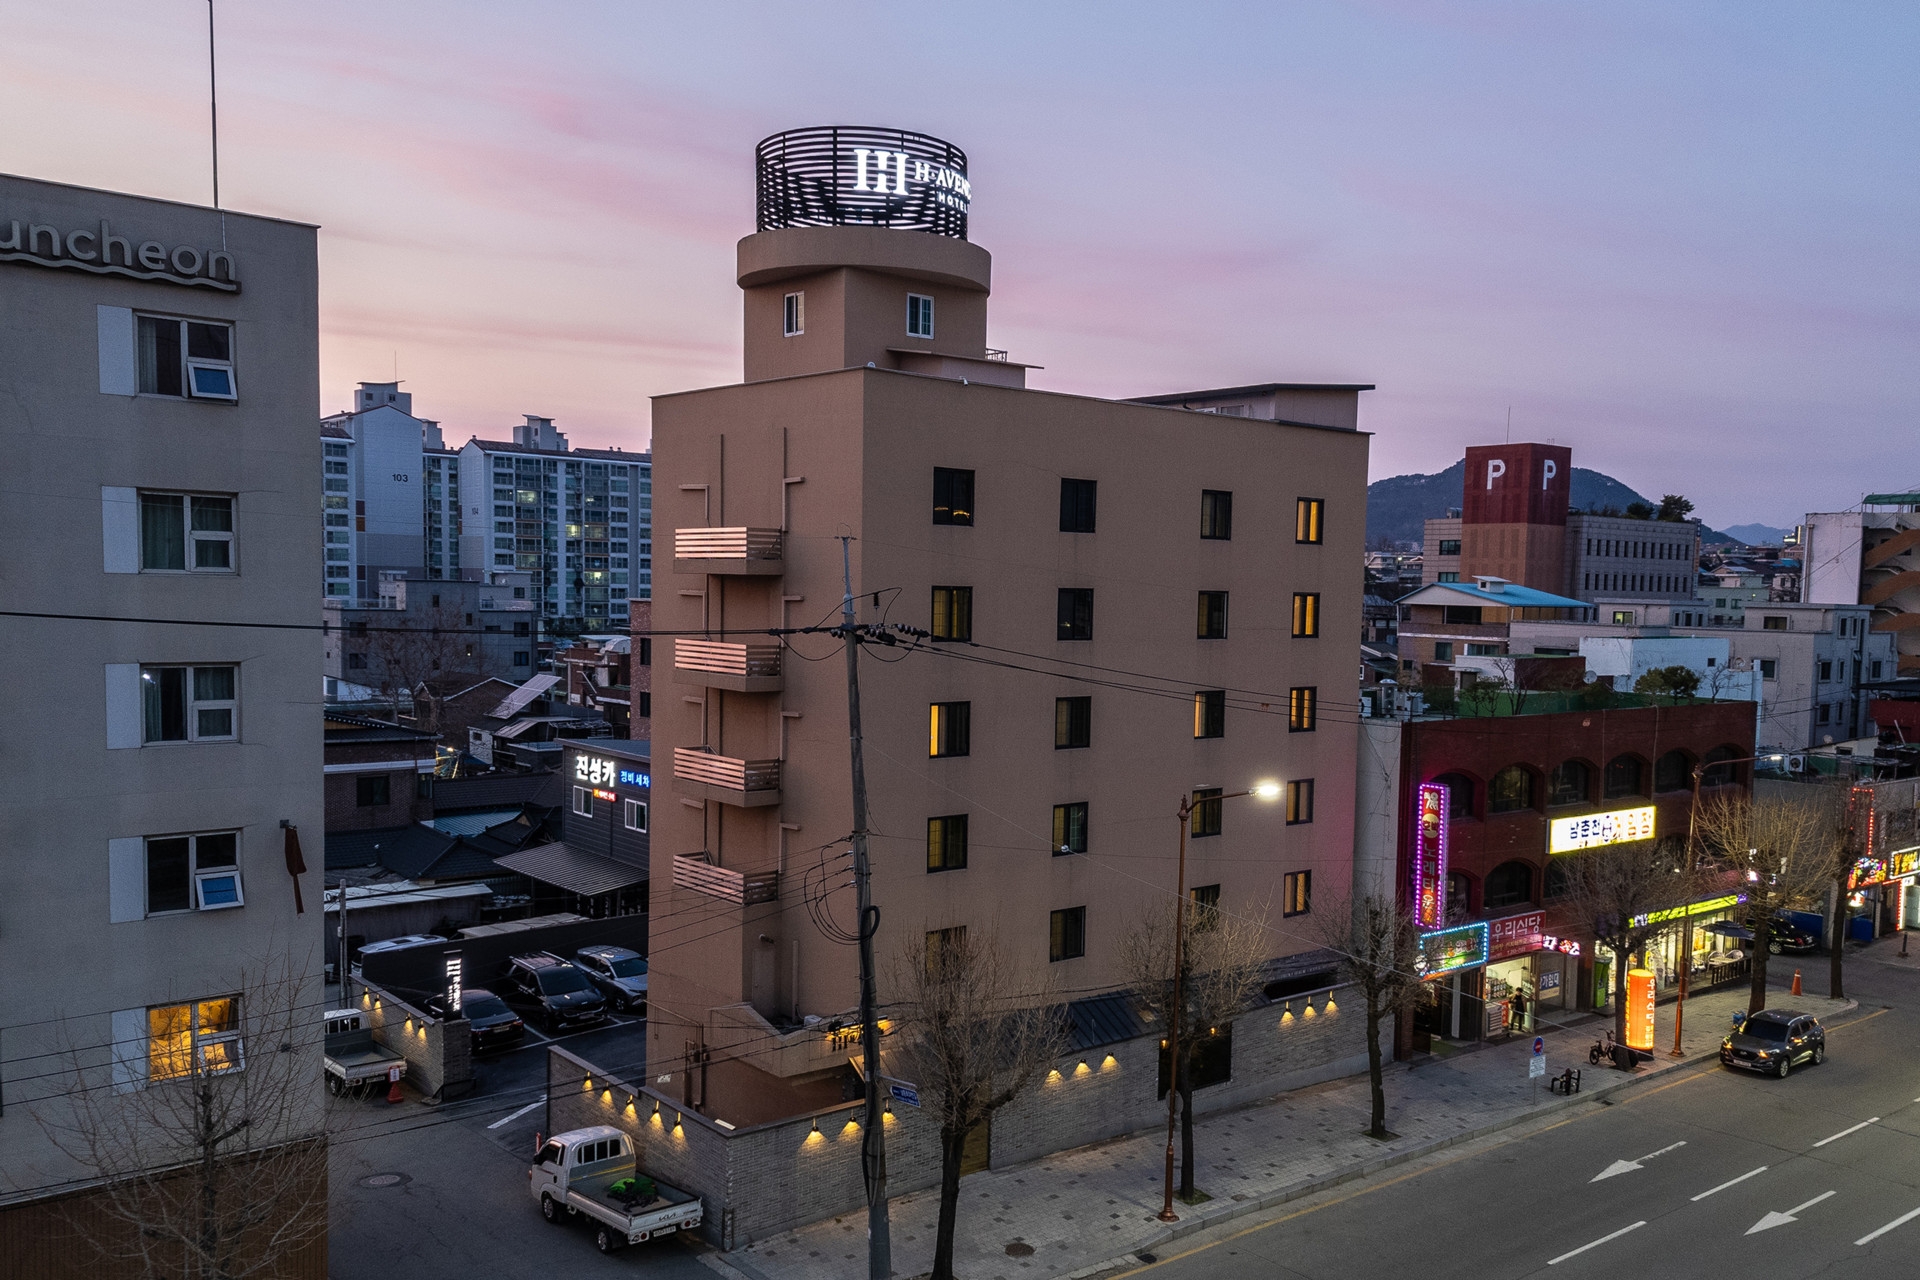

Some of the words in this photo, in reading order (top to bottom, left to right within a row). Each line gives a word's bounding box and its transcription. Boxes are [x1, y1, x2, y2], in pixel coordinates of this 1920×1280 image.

[392, 473, 409, 483] 103
[1486, 459, 1506, 490] P
[1542, 459, 1557, 490] P
[1491, 915, 1541, 942] 우리식당
[1540, 971, 1560, 988] 가임대
